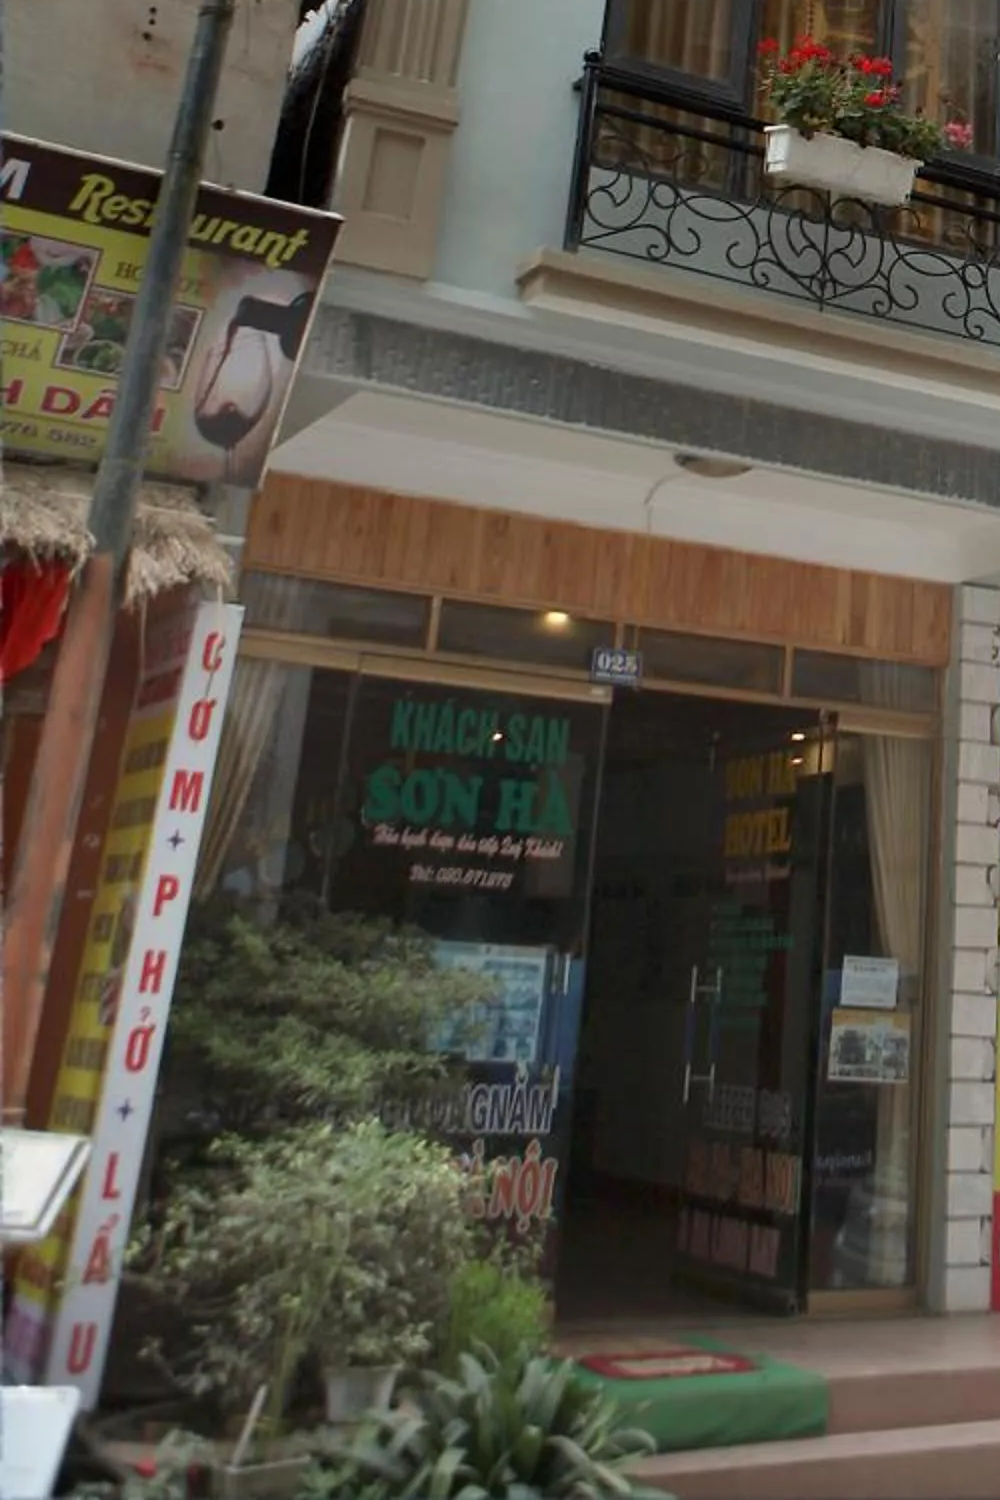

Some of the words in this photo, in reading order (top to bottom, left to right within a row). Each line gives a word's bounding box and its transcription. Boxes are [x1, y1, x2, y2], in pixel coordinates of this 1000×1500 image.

[69, 173, 310, 268] Resurant
[390, 697, 500, 760] KHÁCH
[505, 712, 571, 772] SẠN
